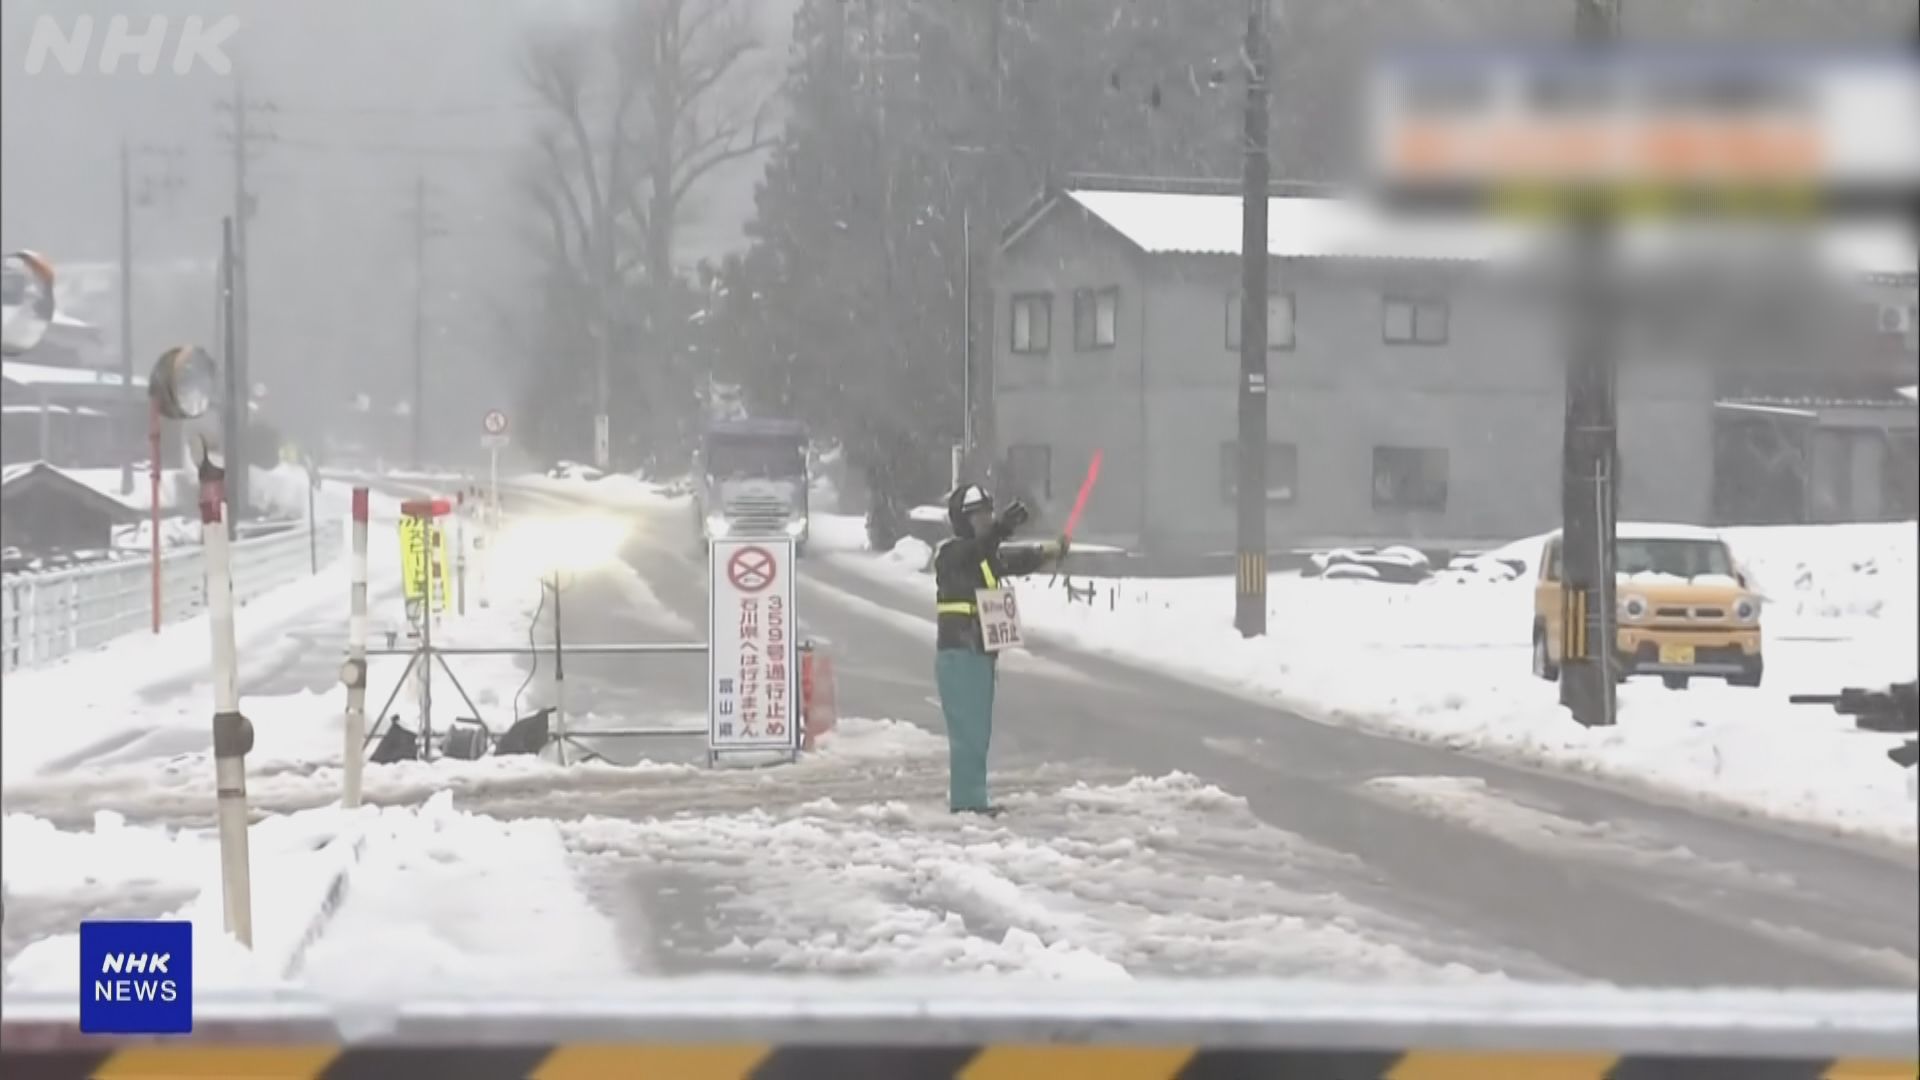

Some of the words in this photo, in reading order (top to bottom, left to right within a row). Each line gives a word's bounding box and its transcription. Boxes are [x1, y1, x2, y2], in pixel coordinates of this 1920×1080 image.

[719, 678, 733, 737] 富山県
[740, 598, 759, 738] 石川県へは行けません
[766, 595, 785, 736] 359号通行止め
